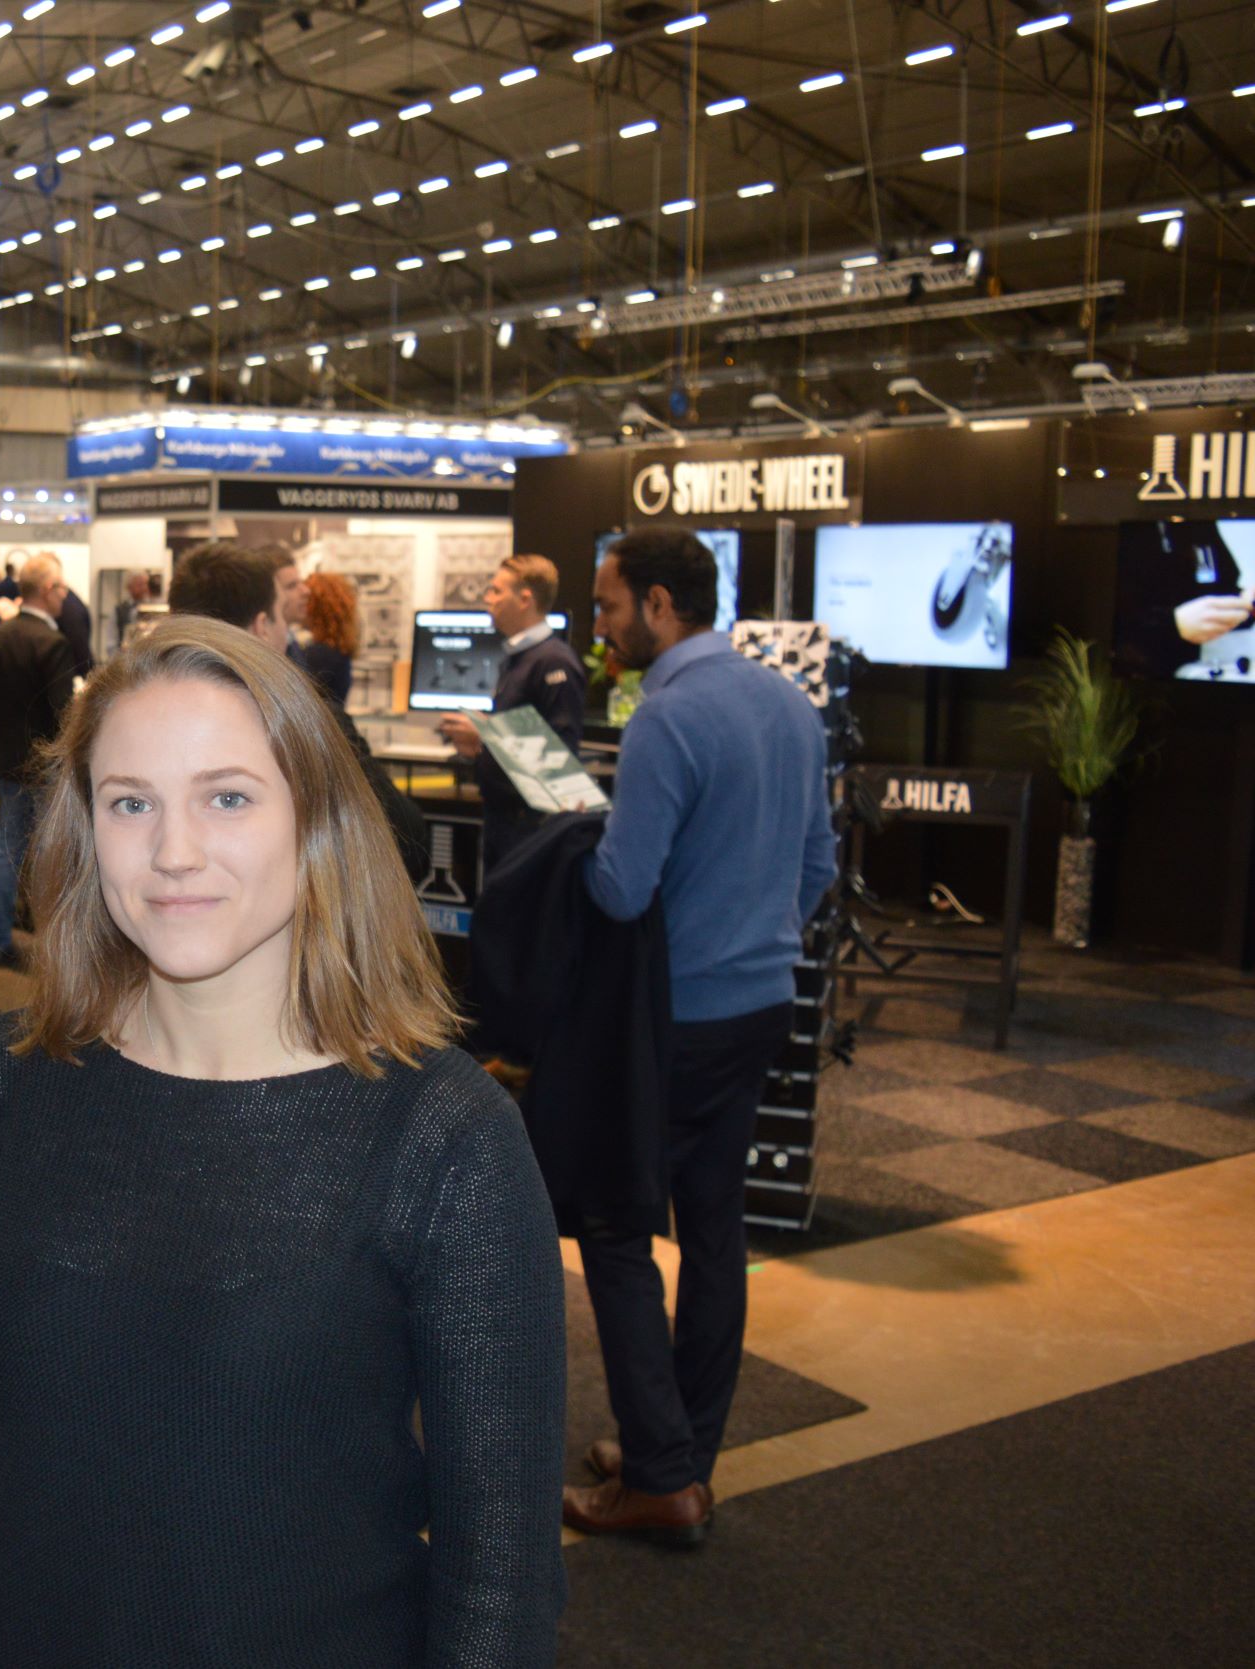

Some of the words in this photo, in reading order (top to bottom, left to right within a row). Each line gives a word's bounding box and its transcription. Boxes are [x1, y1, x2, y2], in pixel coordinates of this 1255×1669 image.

[277, 487, 380, 509] VAGGERYDS
[382, 490, 436, 509] SVARV
[437, 492, 459, 511] AB
[672, 455, 850, 515] SWEDE-WHEEL
[905, 780, 971, 813] HILFA
